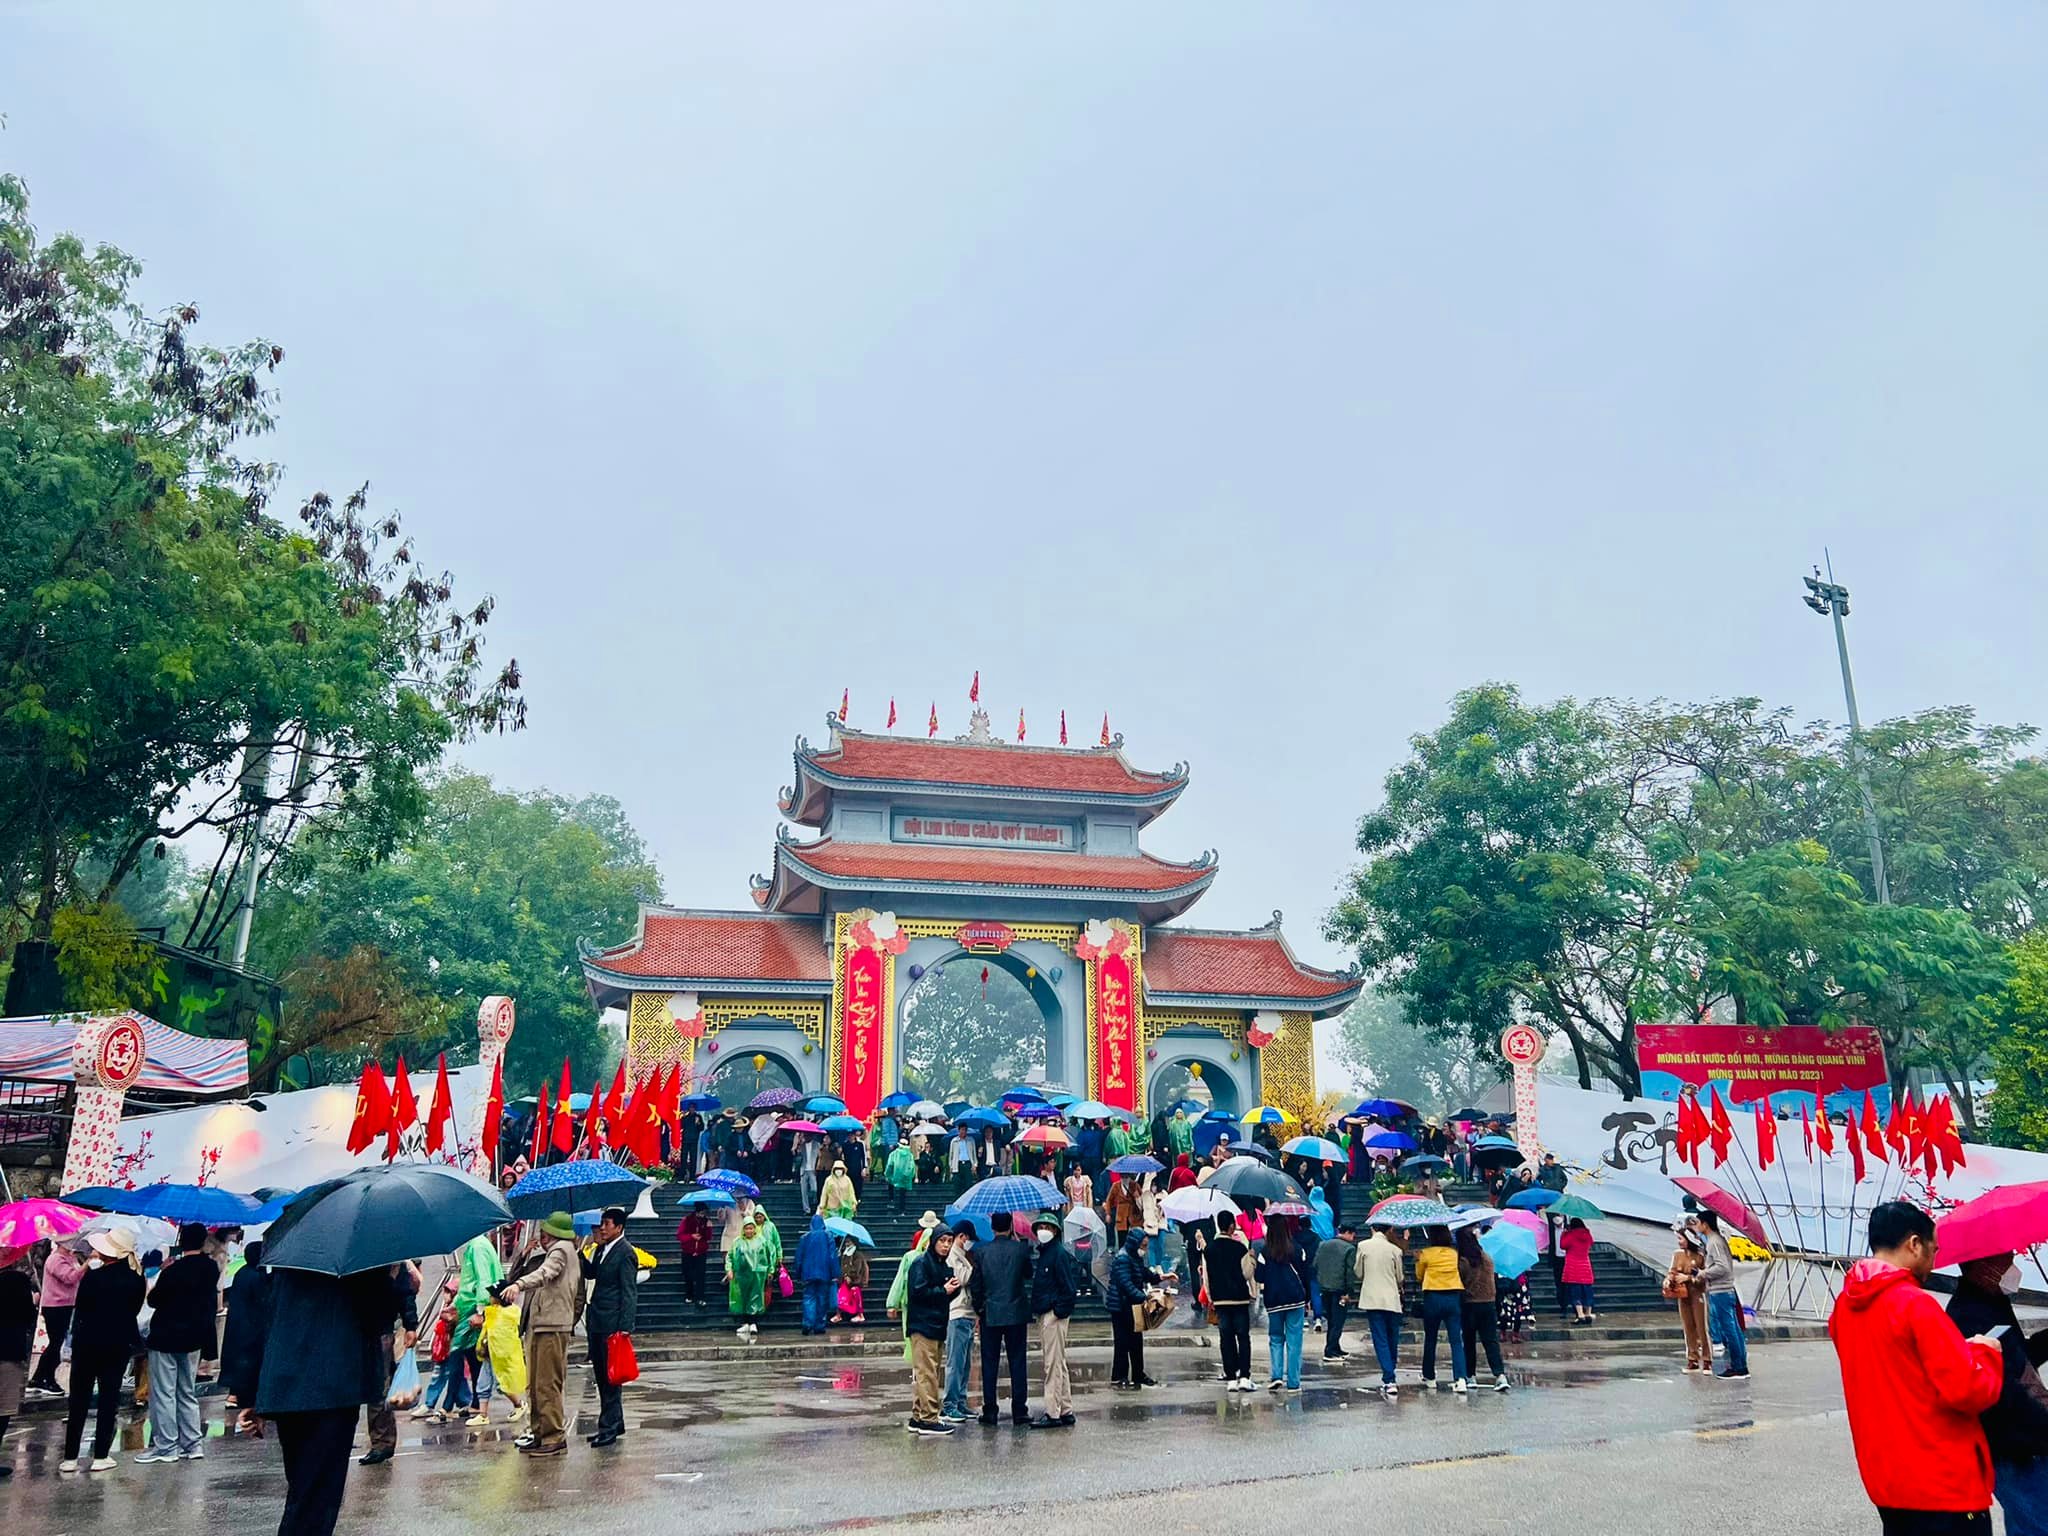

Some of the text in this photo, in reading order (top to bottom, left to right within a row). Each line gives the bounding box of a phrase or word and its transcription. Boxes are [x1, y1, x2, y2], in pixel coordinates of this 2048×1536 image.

[904, 817, 921, 837] HỘI
[924, 820, 942, 835] LIM
[945, 820, 970, 837] KÍNH
[972, 822, 998, 839] CHÀO
[1001, 823, 1022, 841] QUÝ
[1024, 825, 1058, 843] KHÁCH
[1657, 1051, 1866, 1066] MỪNG ĐẤT NƯỚC ĐỔI MỚI, MỪNG ĐẢNG QUANG VINH
[1707, 1067, 1733, 1080] MỪNG
[1735, 1068, 1759, 1080] XUÂN
[1760, 1068, 1777, 1080] QUÝ
[1778, 1068, 1798, 1080] MÃO
